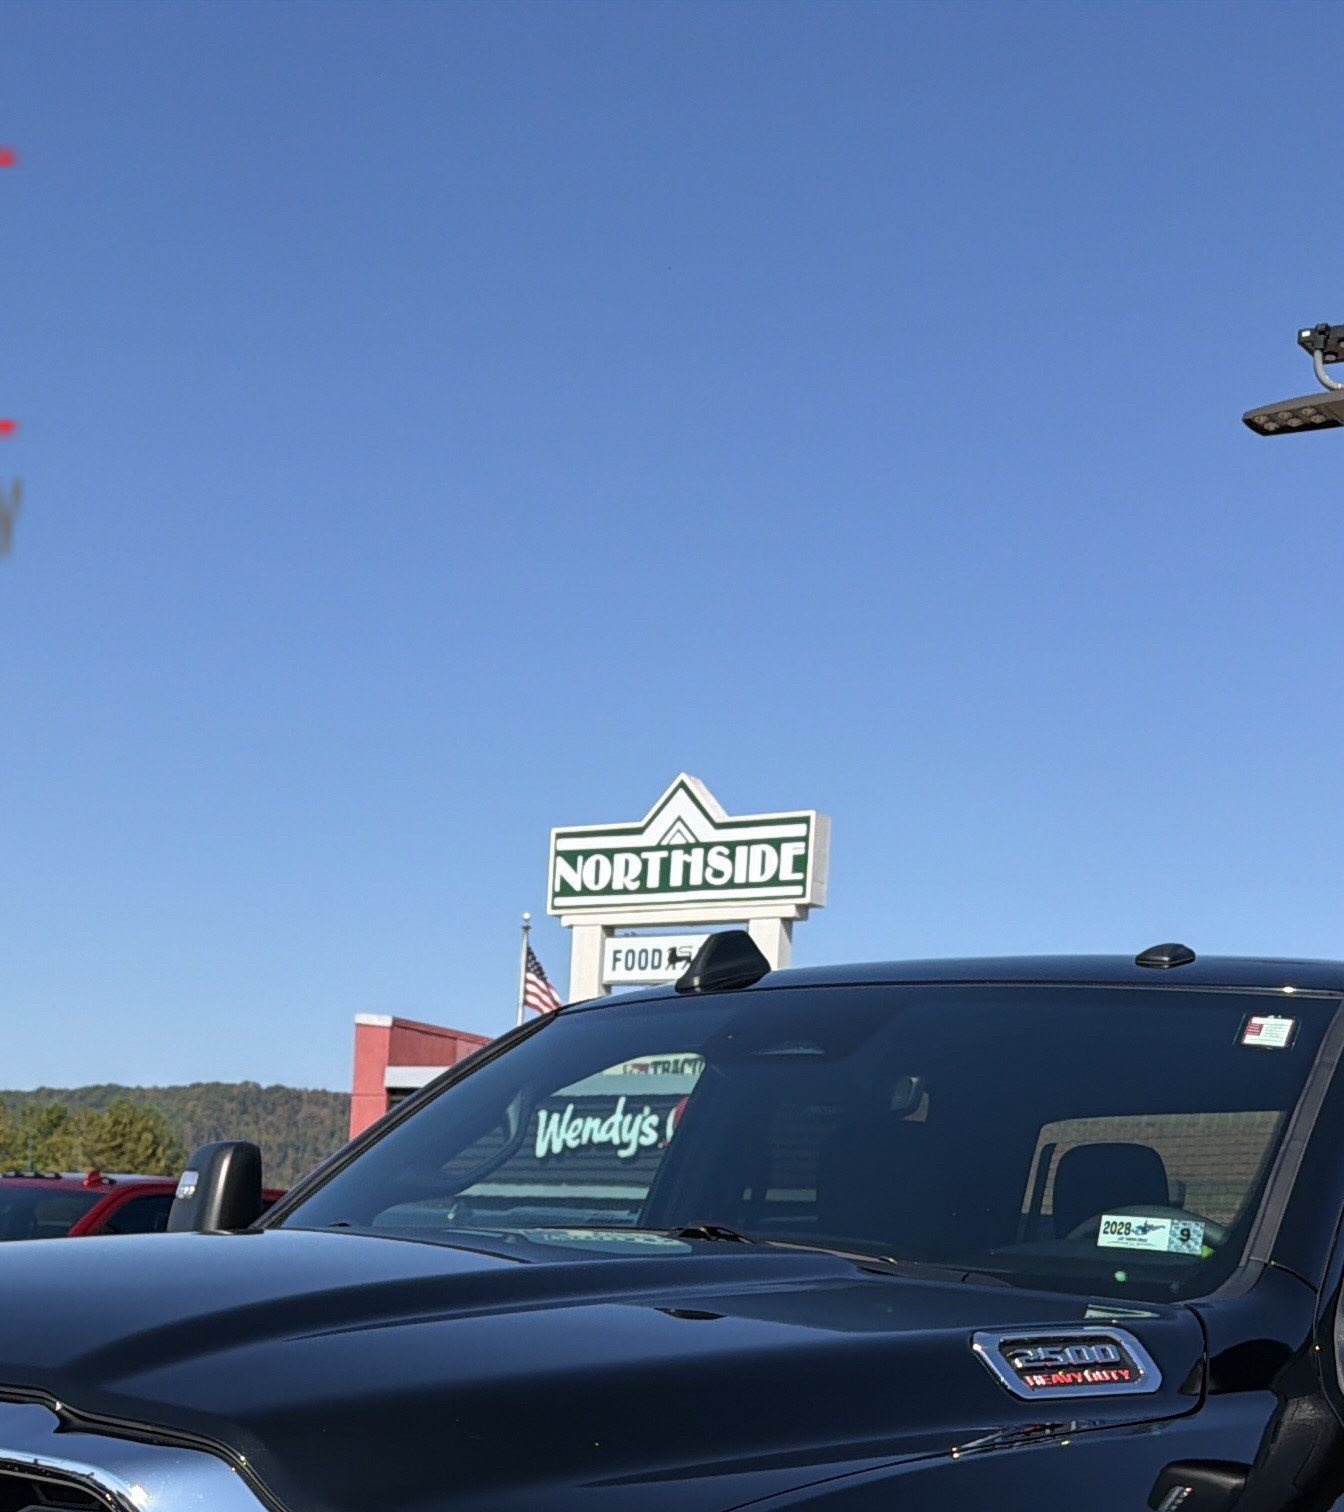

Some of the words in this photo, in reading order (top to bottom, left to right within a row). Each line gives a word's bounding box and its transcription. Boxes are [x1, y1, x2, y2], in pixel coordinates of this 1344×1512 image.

[554, 841, 806, 892] NORTHSIDE
[611, 948, 663, 971] FOOD
[535, 1096, 660, 1159] Wendy's
[1102, 1220, 1132, 1236] 2028
[1179, 1227, 1191, 1243] 9
[1009, 1344, 1121, 1368] 2500
[1024, 1370, 1084, 1387] HEAVY
[1084, 1368, 1132, 1383] DUTY
